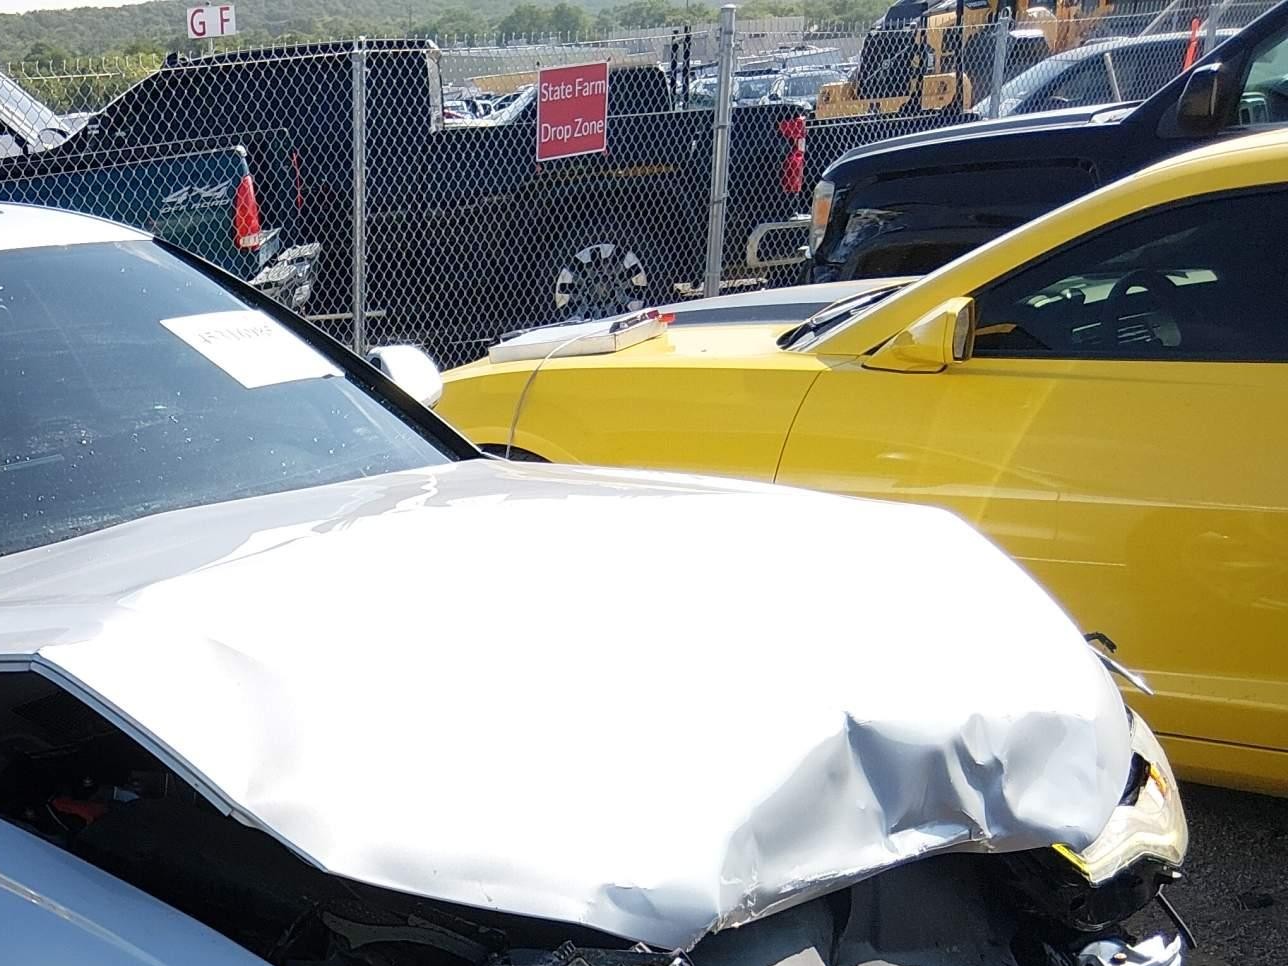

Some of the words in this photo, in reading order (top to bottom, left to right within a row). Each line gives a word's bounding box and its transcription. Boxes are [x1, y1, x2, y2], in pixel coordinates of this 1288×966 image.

[190, 8, 206, 37] G
[219, 6, 230, 35] F
[541, 82, 572, 102] State
[575, 78, 606, 97] Farm
[541, 123, 572, 143] Drop
[574, 118, 604, 137] Zone
